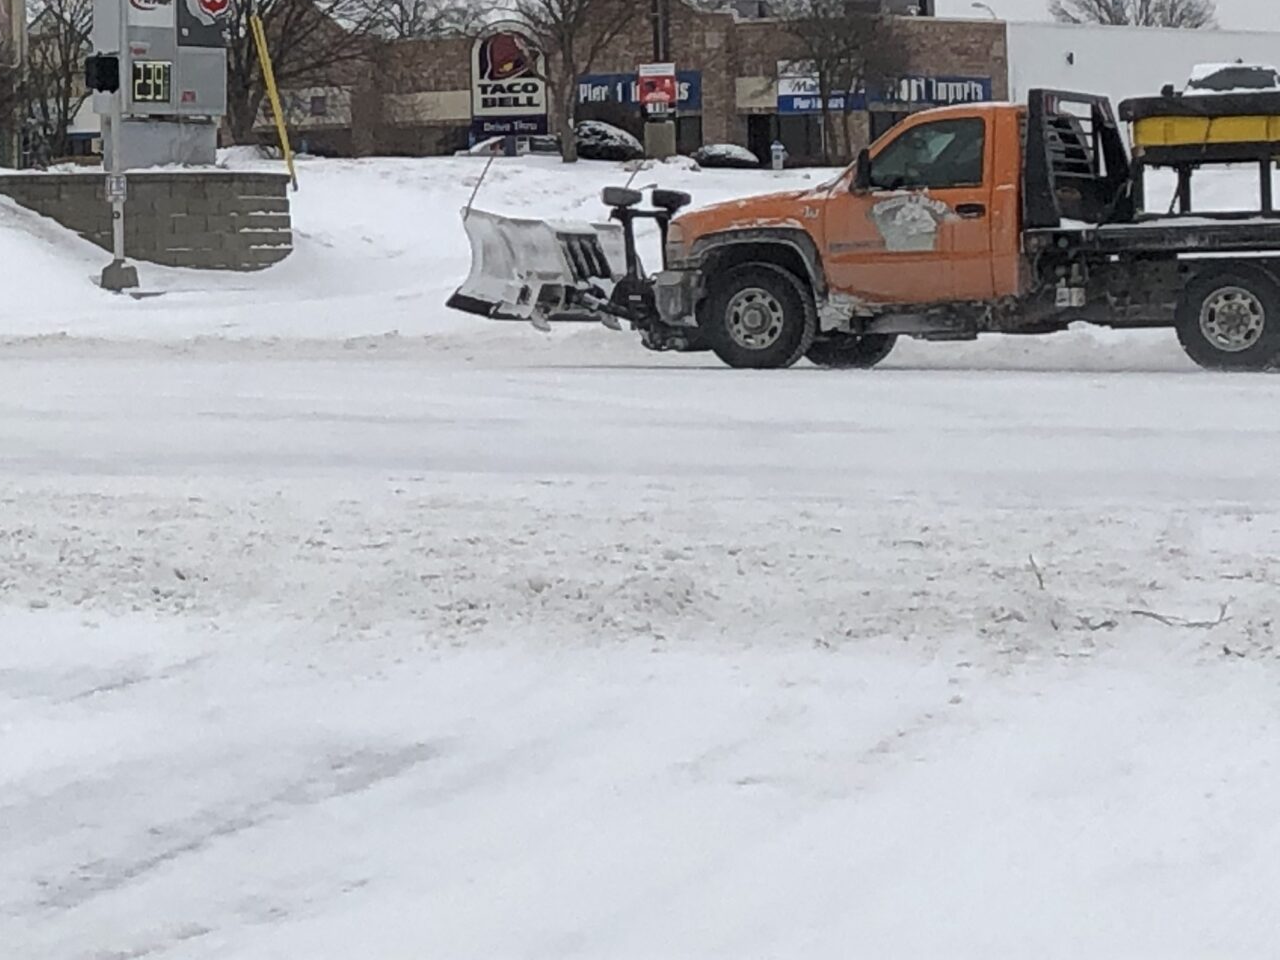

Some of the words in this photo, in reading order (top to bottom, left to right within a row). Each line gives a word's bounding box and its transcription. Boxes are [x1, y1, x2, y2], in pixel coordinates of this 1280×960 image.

[477, 82, 539, 95] TACO
[579, 83, 608, 104] Pier
[481, 95, 541, 109] BELL
